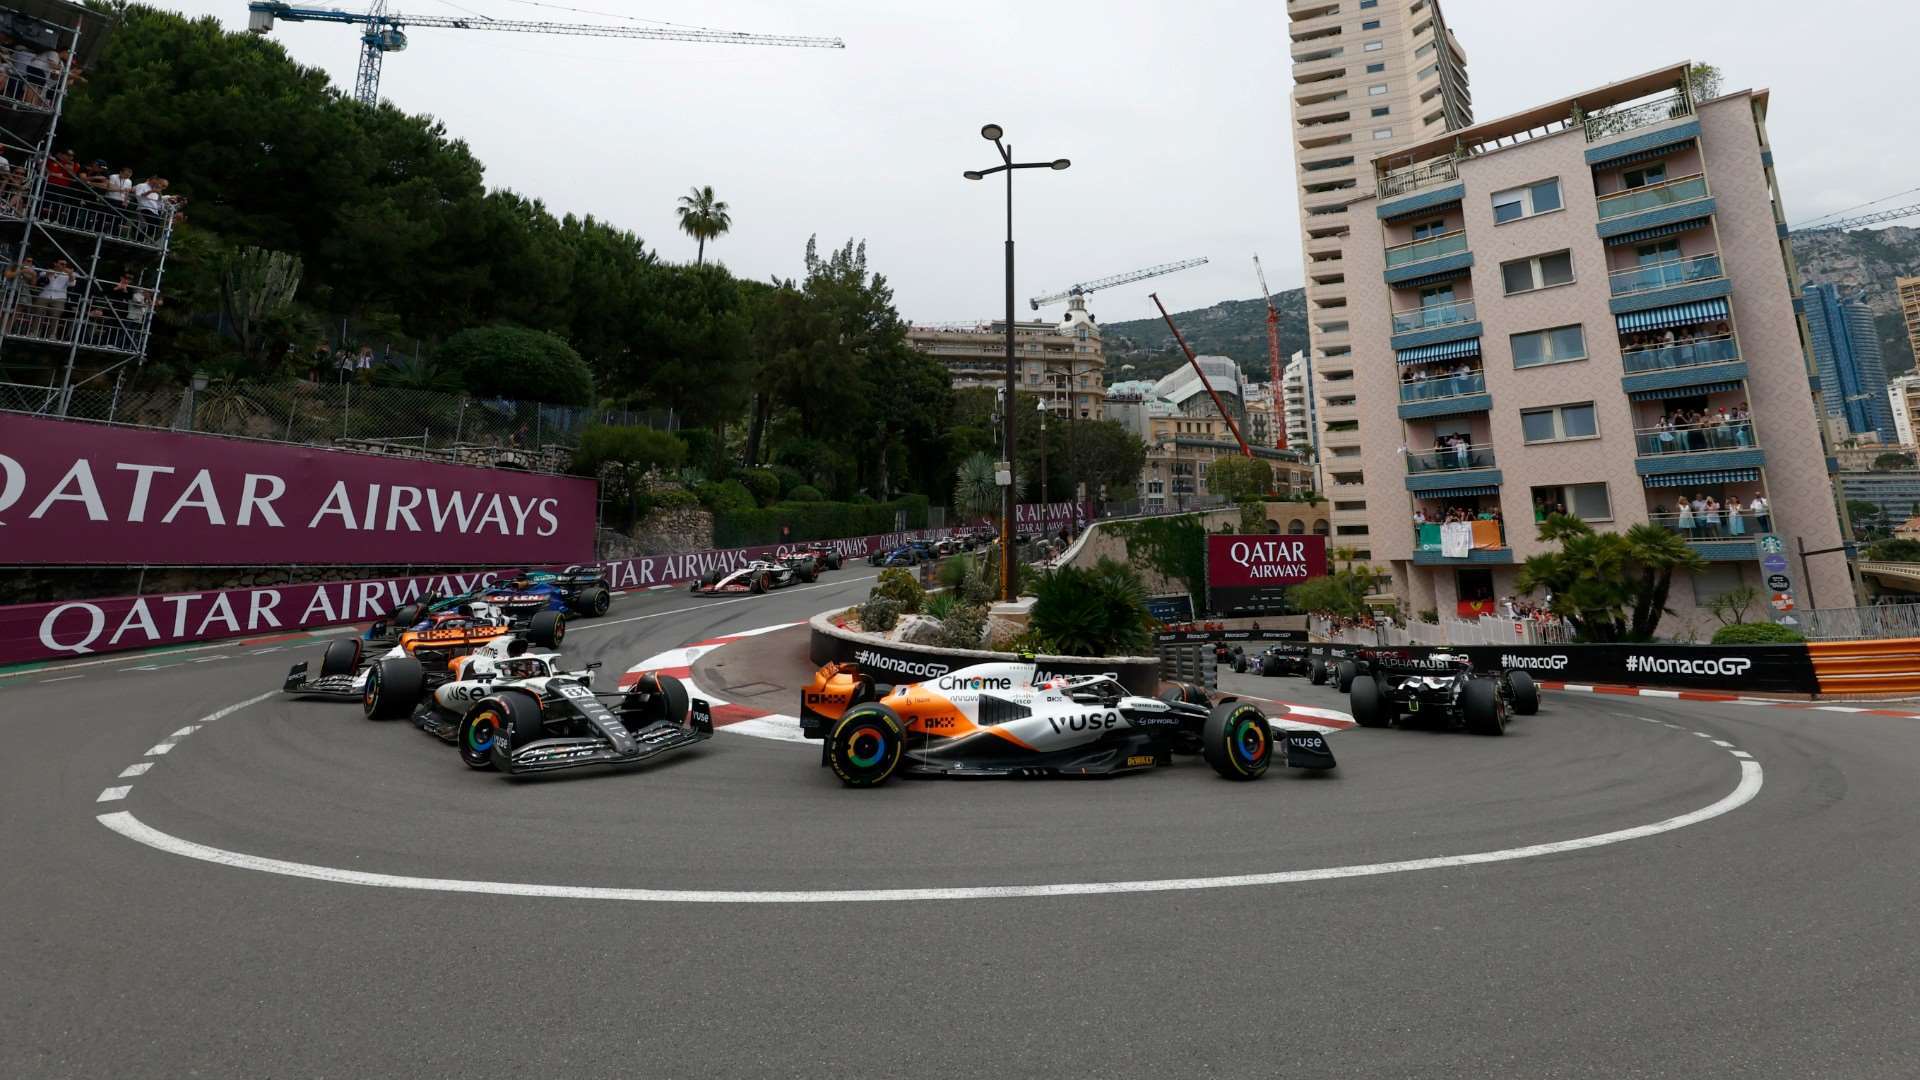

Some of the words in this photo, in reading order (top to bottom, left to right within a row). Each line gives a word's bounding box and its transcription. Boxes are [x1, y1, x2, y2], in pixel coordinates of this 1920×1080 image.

[307, 480, 560, 537] AIRWAYS
[879, 533, 900, 550] QATAR
[1230, 541, 1306, 567] QATAR
[563, 557, 656, 589] TAR
[661, 550, 748, 581] AIRWAYS
[1250, 564, 1308, 578] AIRWAYS
[39, 588, 284, 654] QATAR
[298, 572, 499, 625] AIRWAYS
[854, 650, 949, 677] #MonacoGP
[1378, 659, 1449, 669] ALPHATAURI
[1501, 653, 1568, 671] #MonacoGP
[1626, 655, 1751, 676] #MonacoGP
[938, 675, 1012, 691] Chrome
